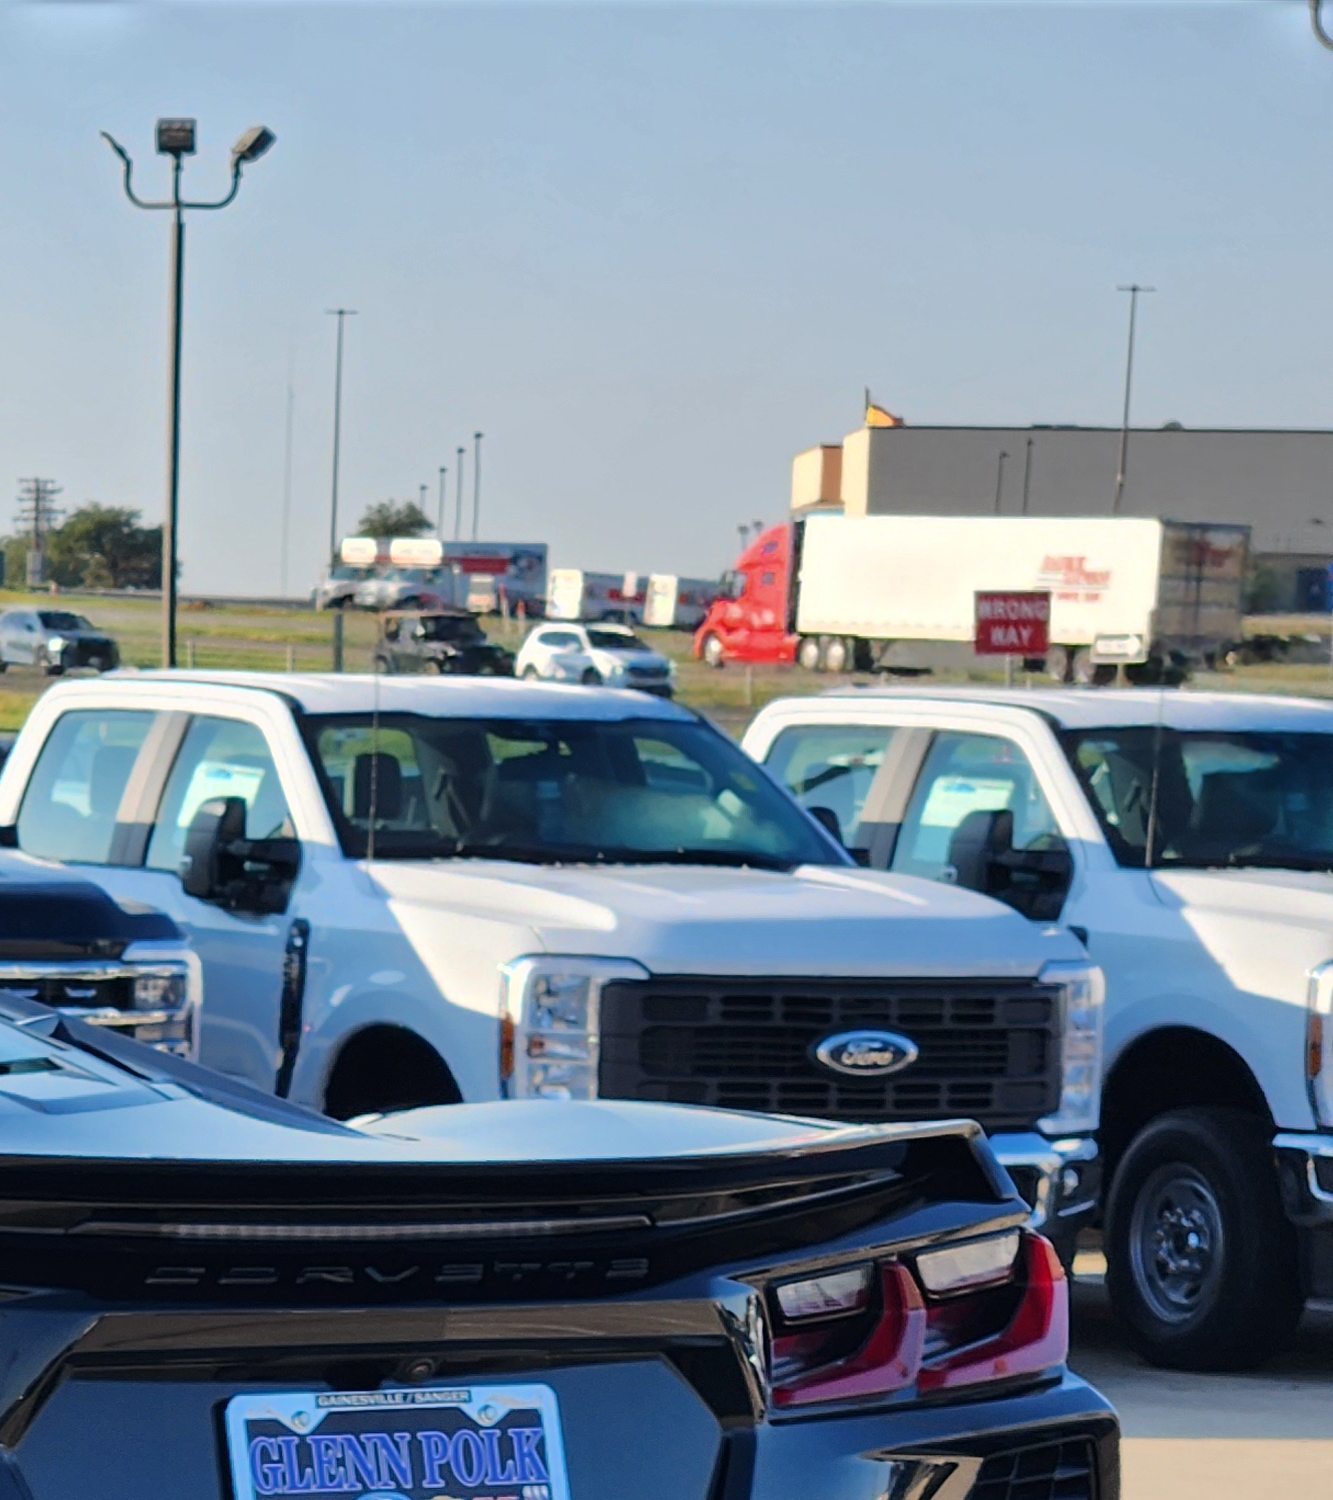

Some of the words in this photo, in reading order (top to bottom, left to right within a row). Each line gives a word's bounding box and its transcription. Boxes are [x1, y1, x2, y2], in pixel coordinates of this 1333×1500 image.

[977, 600, 1048, 620] WRONG
[989, 624, 1032, 647] WAY
[841, 1040, 895, 1066] Ford
[144, 1257, 650, 1285] CORVETTE
[318, 1393, 403, 1406] GAINESVILLE
[414, 1389, 470, 1403] SANGER
[250, 1433, 412, 1494] GLENN
[418, 1428, 550, 1487] POLK
